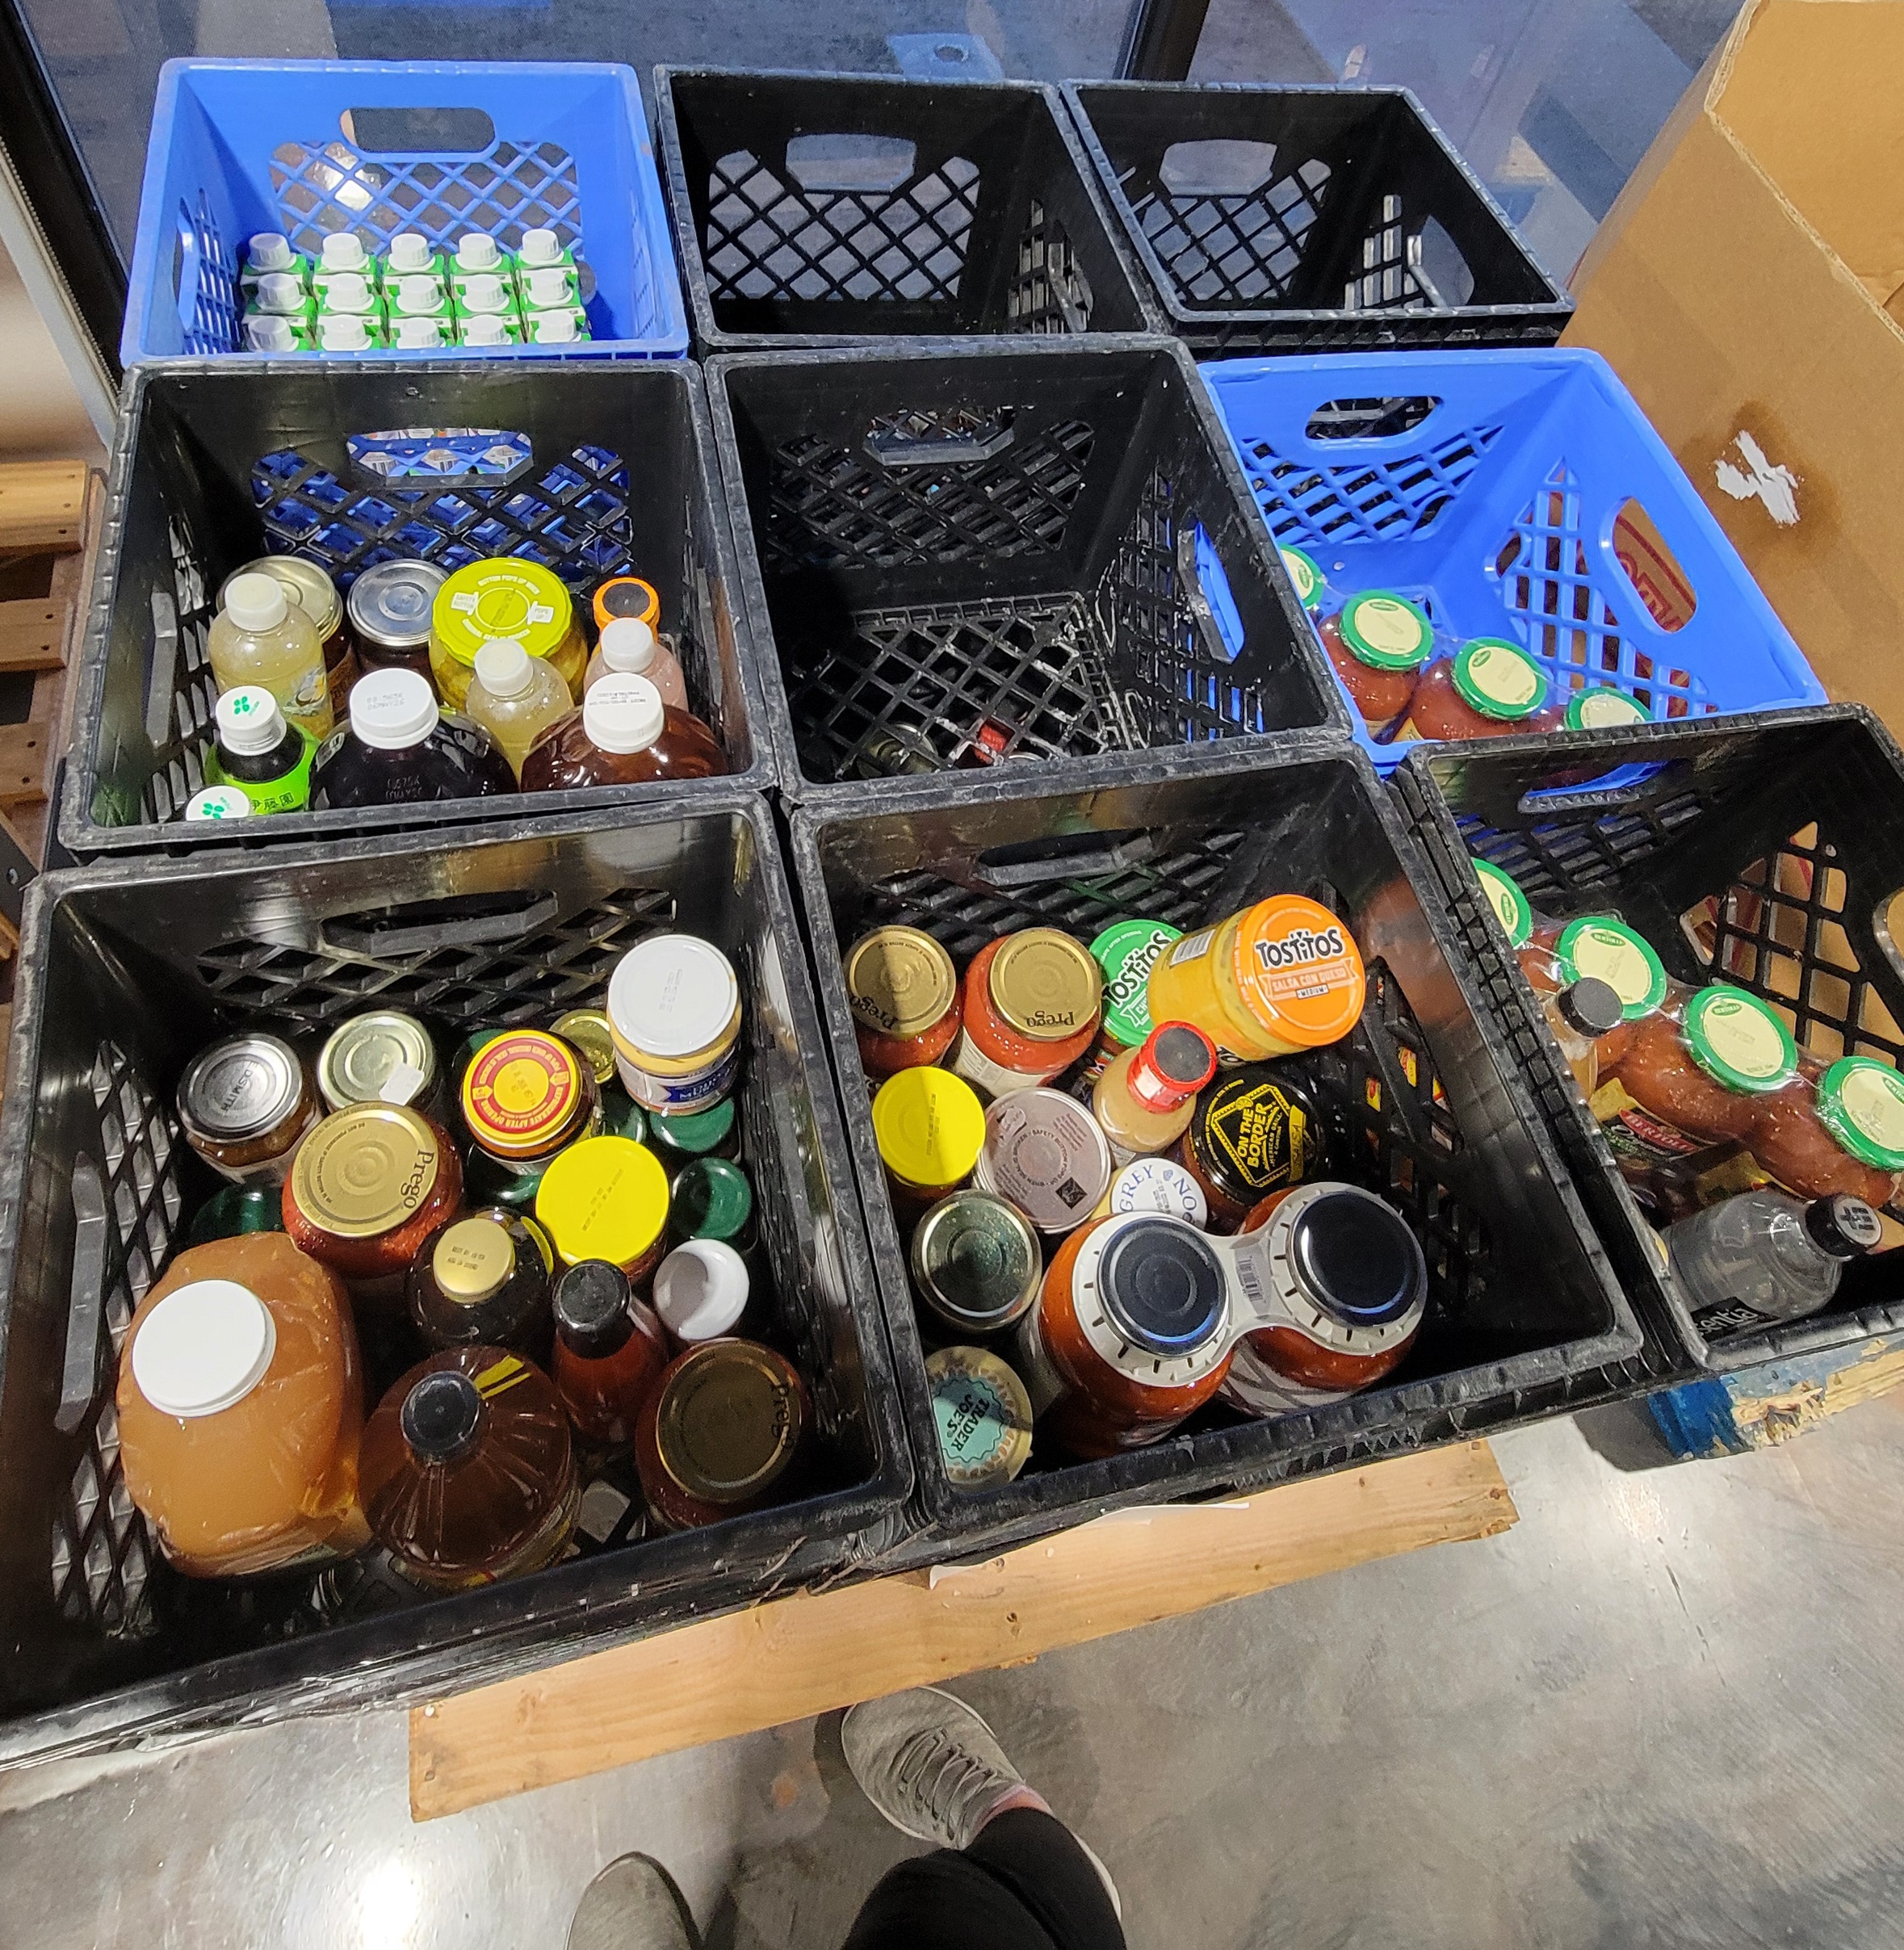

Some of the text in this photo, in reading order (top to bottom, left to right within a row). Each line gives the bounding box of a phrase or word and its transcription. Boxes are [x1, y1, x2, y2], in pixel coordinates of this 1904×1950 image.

[1272, 967, 1346, 992] SALSA CON QUESO
[1301, 987, 1323, 996] MEDIUM
[849, 996, 898, 1030] Prego
[1026, 1010, 1075, 1027] Prego
[505, 1118, 528, 1128] AFTER
[1031, 1129, 1055, 1139] SAFETY
[1238, 1109, 1253, 1157] ON THE
[1247, 1103, 1273, 1167] BORDER
[1055, 1138, 1068, 1163] BUTTON
[401, 1149, 434, 1209] Prego
[1015, 1164, 1027, 1179] SEAL
[1026, 1177, 1046, 1187] WHEN
[1059, 1162, 1068, 1180] POPS
[1119, 1165, 1153, 1211] GREY
[770, 1384, 797, 1449] Prego
[946, 1394, 974, 1433] JOE'S
[951, 1398, 990, 1452] TRADER
